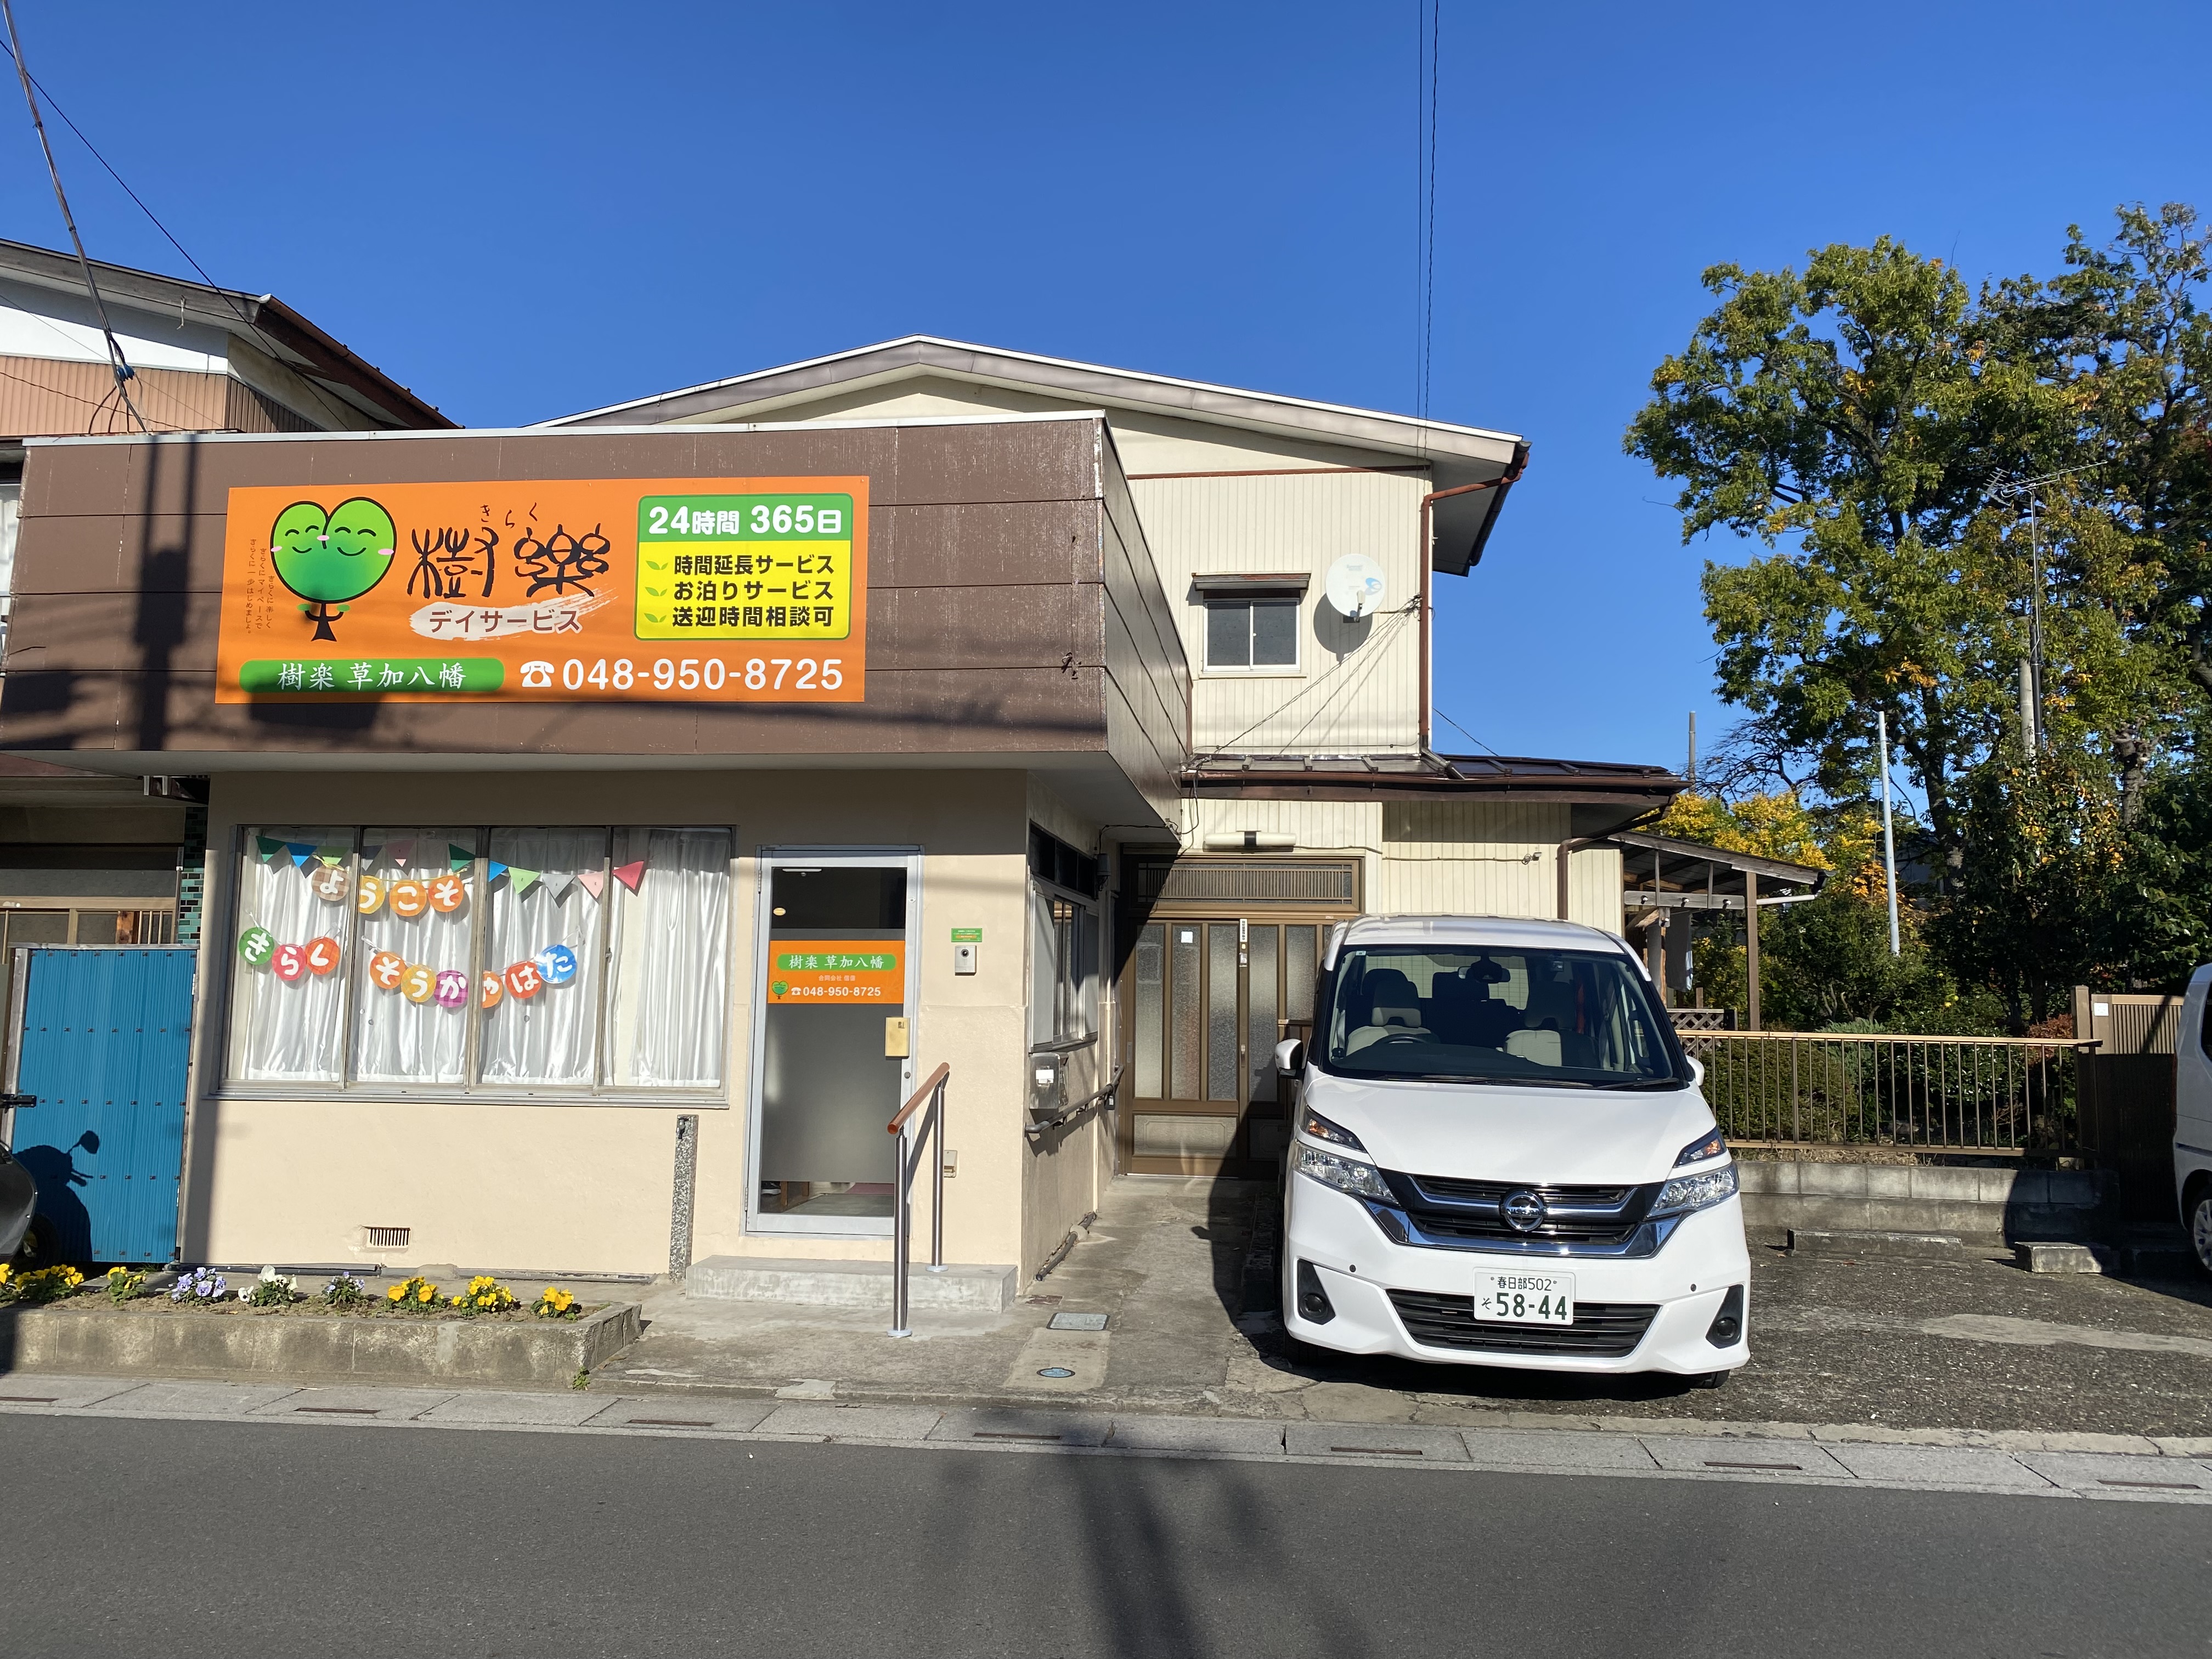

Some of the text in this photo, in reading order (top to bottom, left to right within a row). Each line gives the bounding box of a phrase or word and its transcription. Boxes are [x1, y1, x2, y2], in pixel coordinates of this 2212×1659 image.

[479, 502, 538, 528] きらく
[649, 504, 842, 535] 24時間 365日
[673, 554, 834, 575] 時間延長サービス
[673, 580, 834, 601] お泊りサービス
[429, 608, 580, 633] デイサービス
[672, 606, 834, 627] 送迎時間相談可
[277, 661, 467, 691] 樹楽 草加八幡
[562, 658, 842, 690] 048-950-8725
[320, 870, 459, 911] ようこそ
[245, 932, 329, 975] きらく
[789, 955, 884, 969] 樹楽 草加八幡
[803, 986, 881, 996] 048-950-8725
[1497, 1276, 1551, 1291] 春日部502
[1481, 1292, 1567, 1320] そ 58-44
